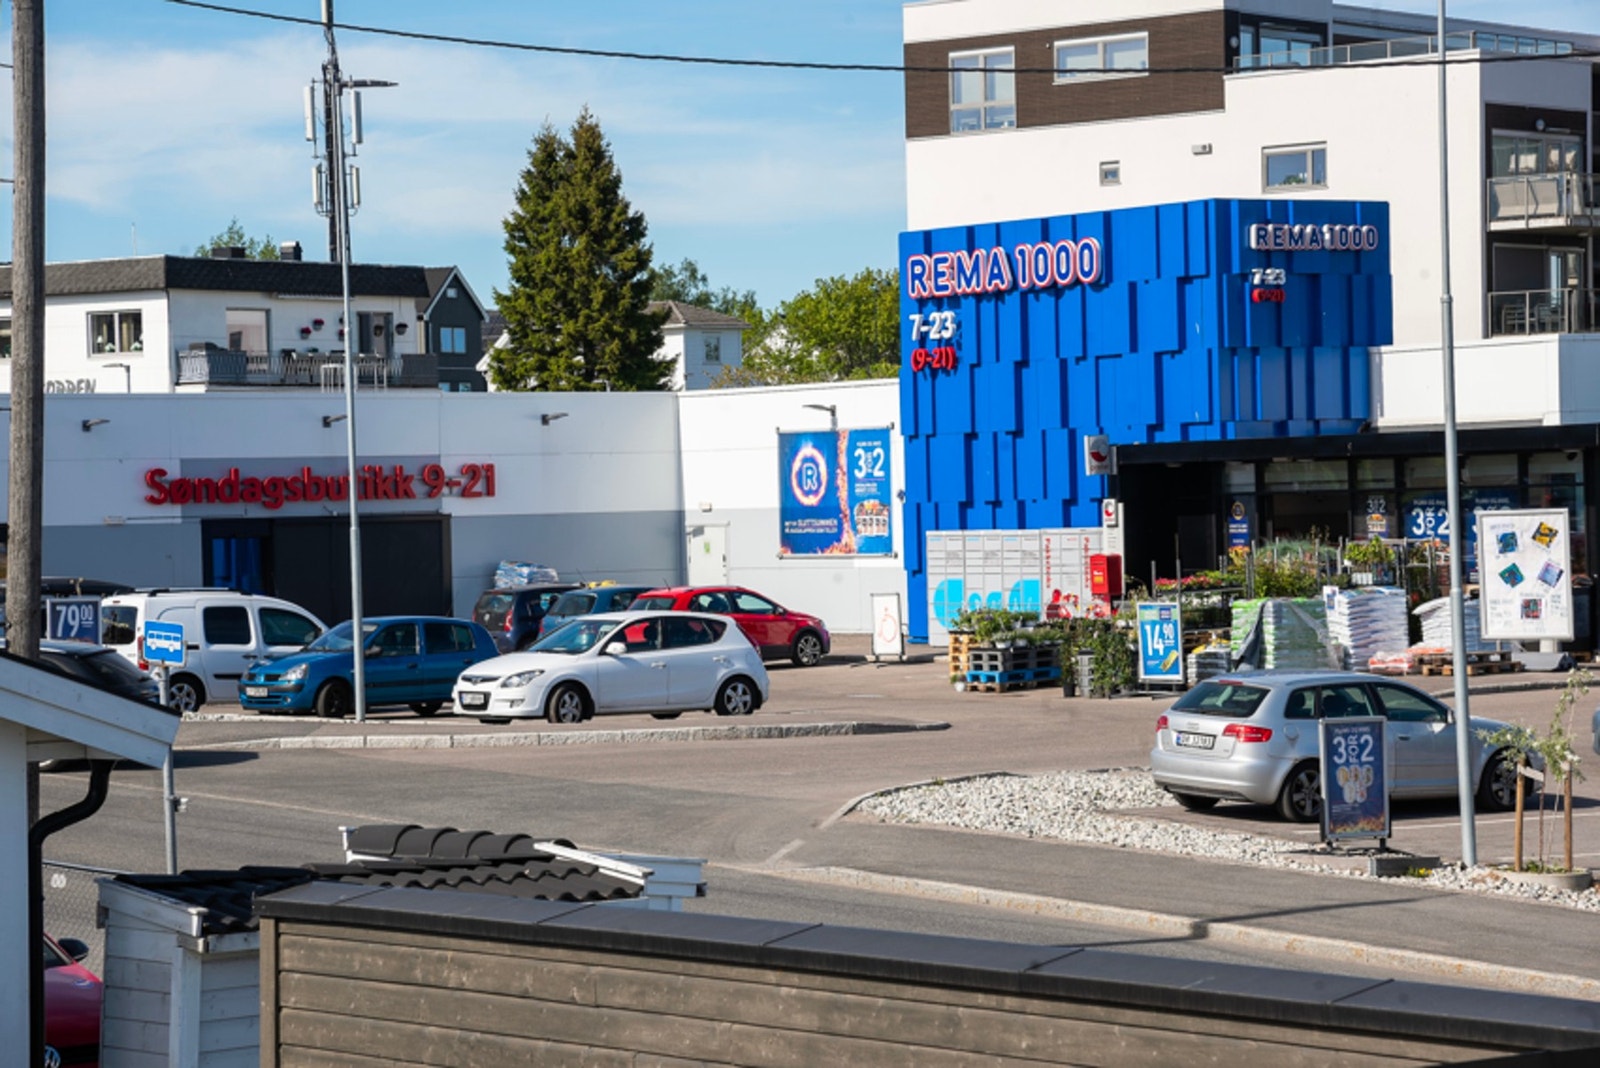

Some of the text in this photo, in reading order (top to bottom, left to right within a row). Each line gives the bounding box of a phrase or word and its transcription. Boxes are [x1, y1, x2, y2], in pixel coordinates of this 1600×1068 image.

[1250, 224, 1378, 250] REMA 1000
[907, 237, 1101, 299] REMA 1000
[1251, 268, 1286, 285] 7-23
[909, 310, 957, 341] 7-23
[911, 346, 958, 372] (9-21)
[854, 448, 867, 478] 3
[873, 447, 886, 477] 2
[422, 463, 495, 498] 9-21
[1411, 508, 1425, 536] 3
[1437, 508, 1450, 535] 2
[1333, 734, 1375, 764] 3 FOR 2
